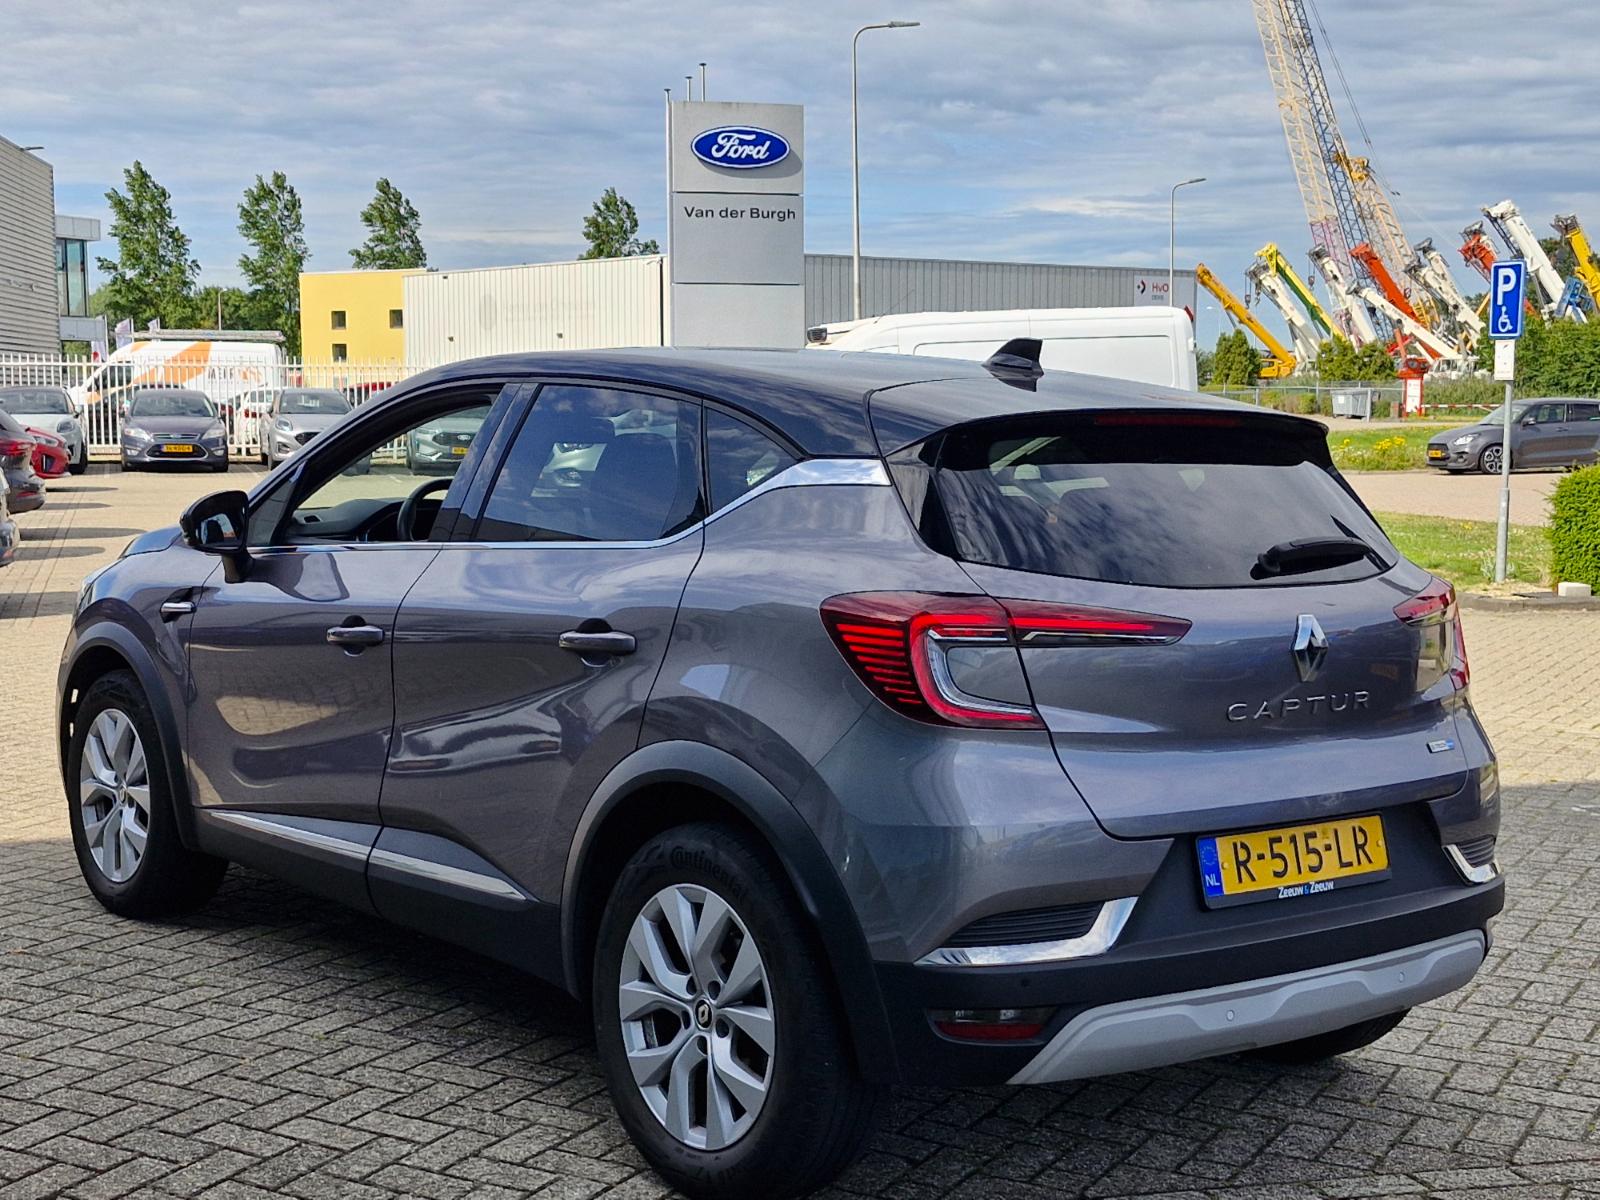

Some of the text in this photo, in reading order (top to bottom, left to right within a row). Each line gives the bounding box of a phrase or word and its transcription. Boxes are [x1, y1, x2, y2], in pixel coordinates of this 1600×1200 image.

[711, 132, 771, 159] Ford
[684, 206, 796, 222] Van der Burgh
[1497, 267, 1517, 306] P
[1227, 690, 1369, 721] CAPTUR
[1232, 826, 1373, 884] R-515-LR
[1205, 873, 1220, 887] NL
